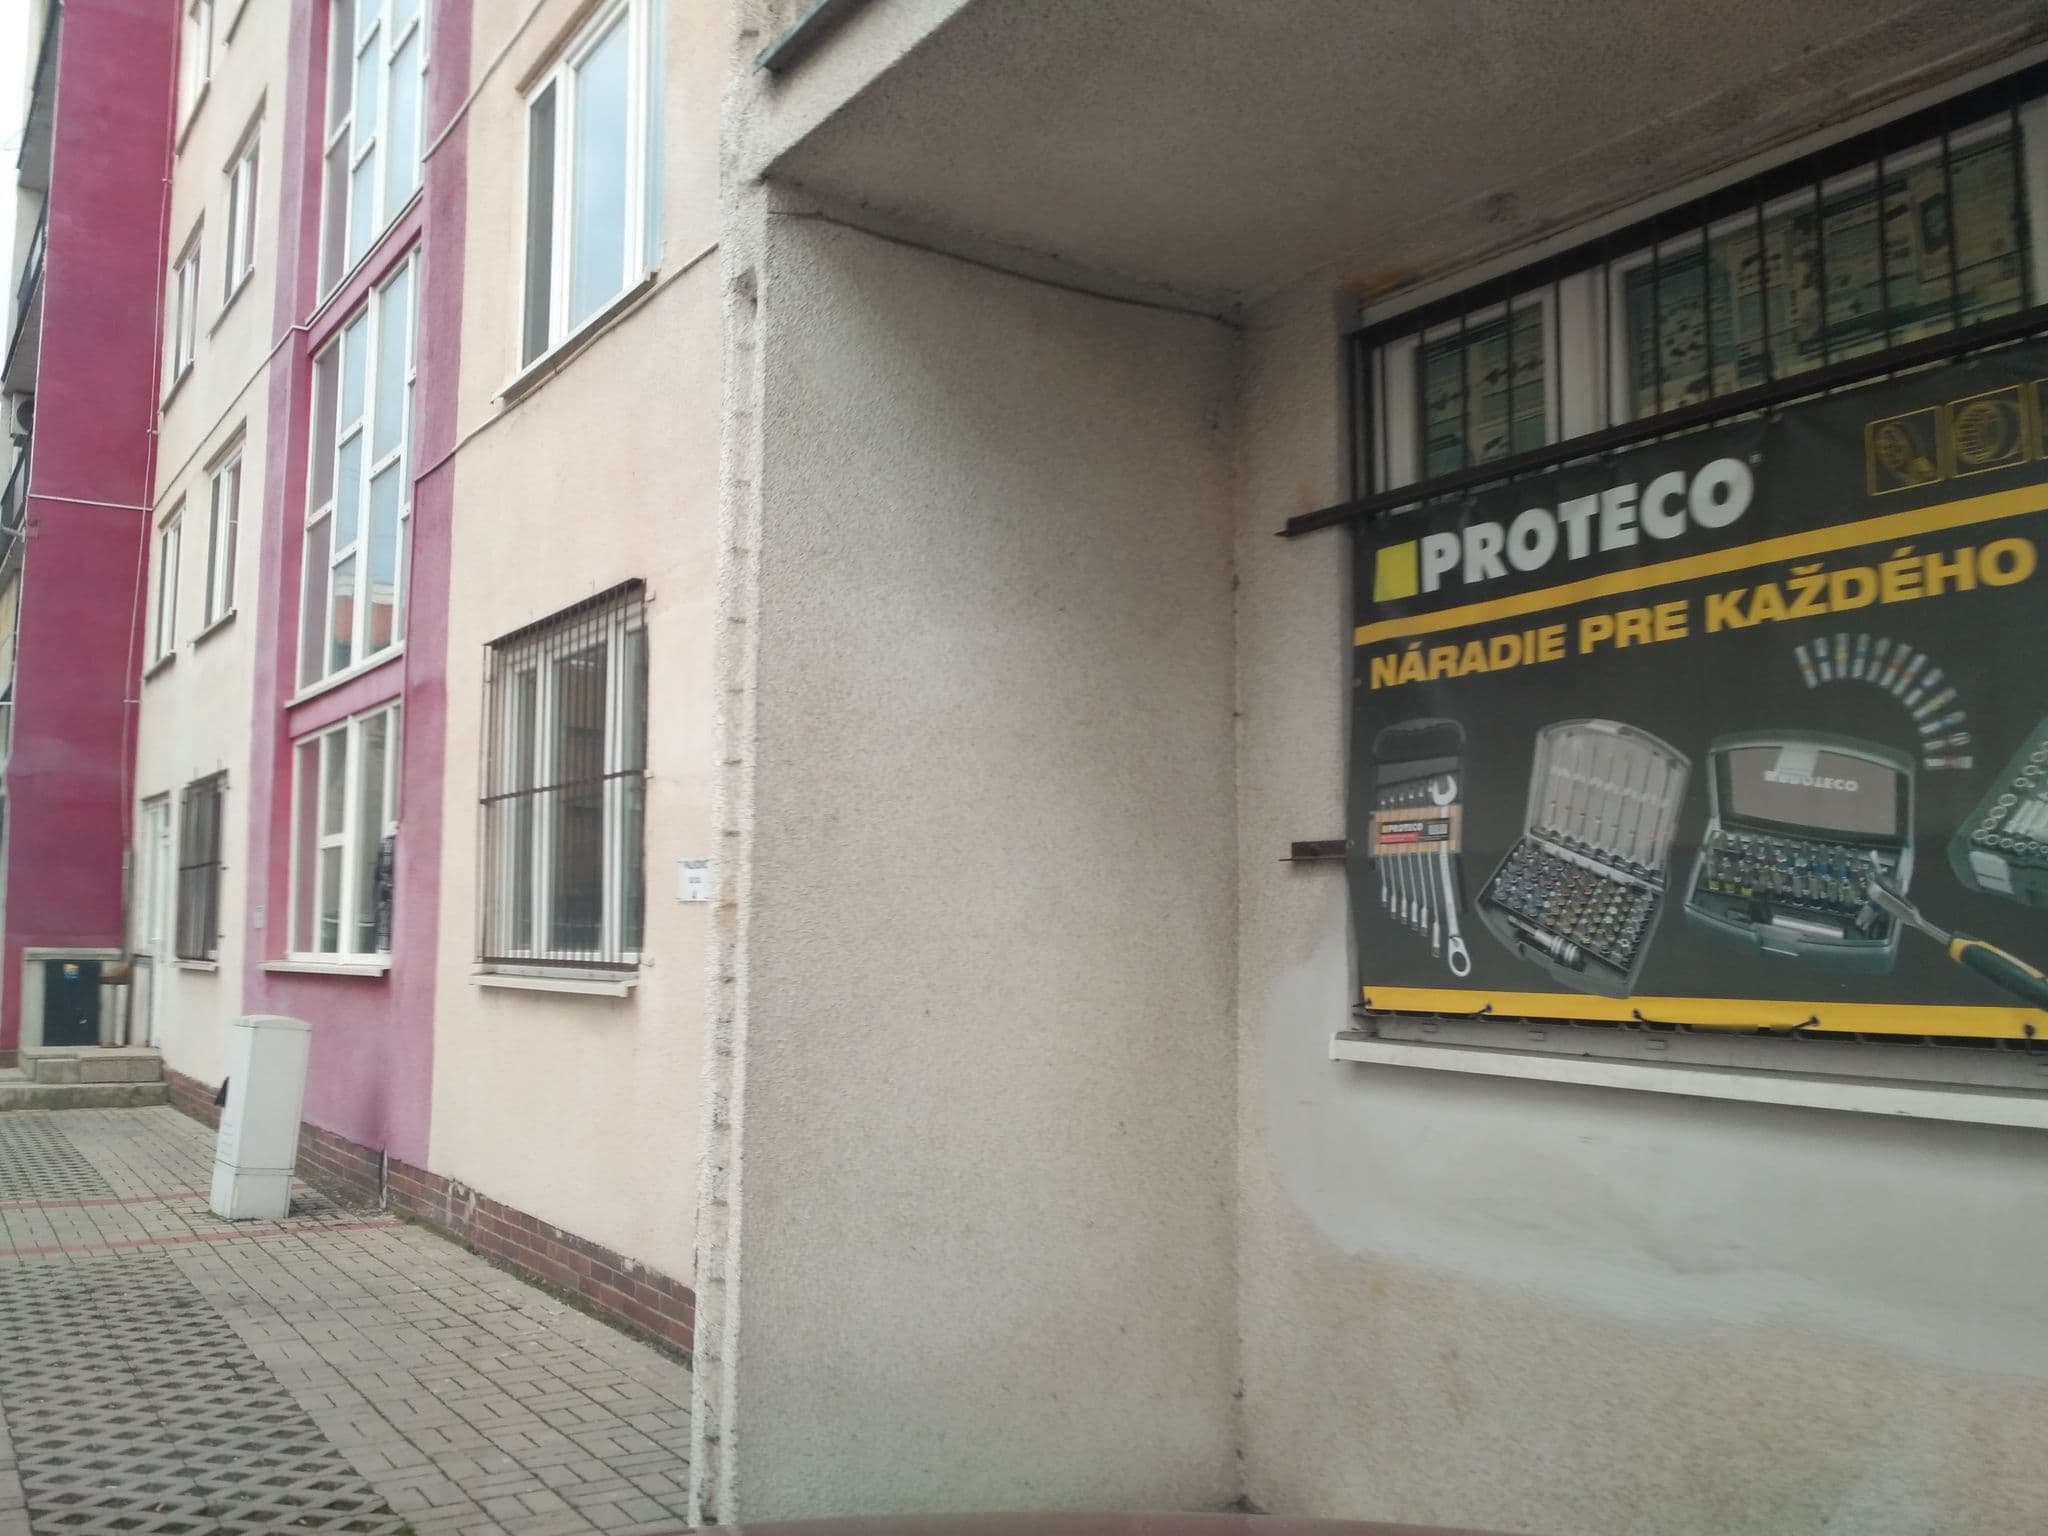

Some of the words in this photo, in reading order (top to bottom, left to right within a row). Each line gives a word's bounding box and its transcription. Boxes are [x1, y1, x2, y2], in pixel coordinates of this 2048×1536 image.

[1420, 457, 1754, 594] PROTECO
[1370, 624, 1566, 689] NÁRADIE
[1578, 600, 1689, 656] PRE
[1704, 536, 2038, 634] KAŽDÉHO
